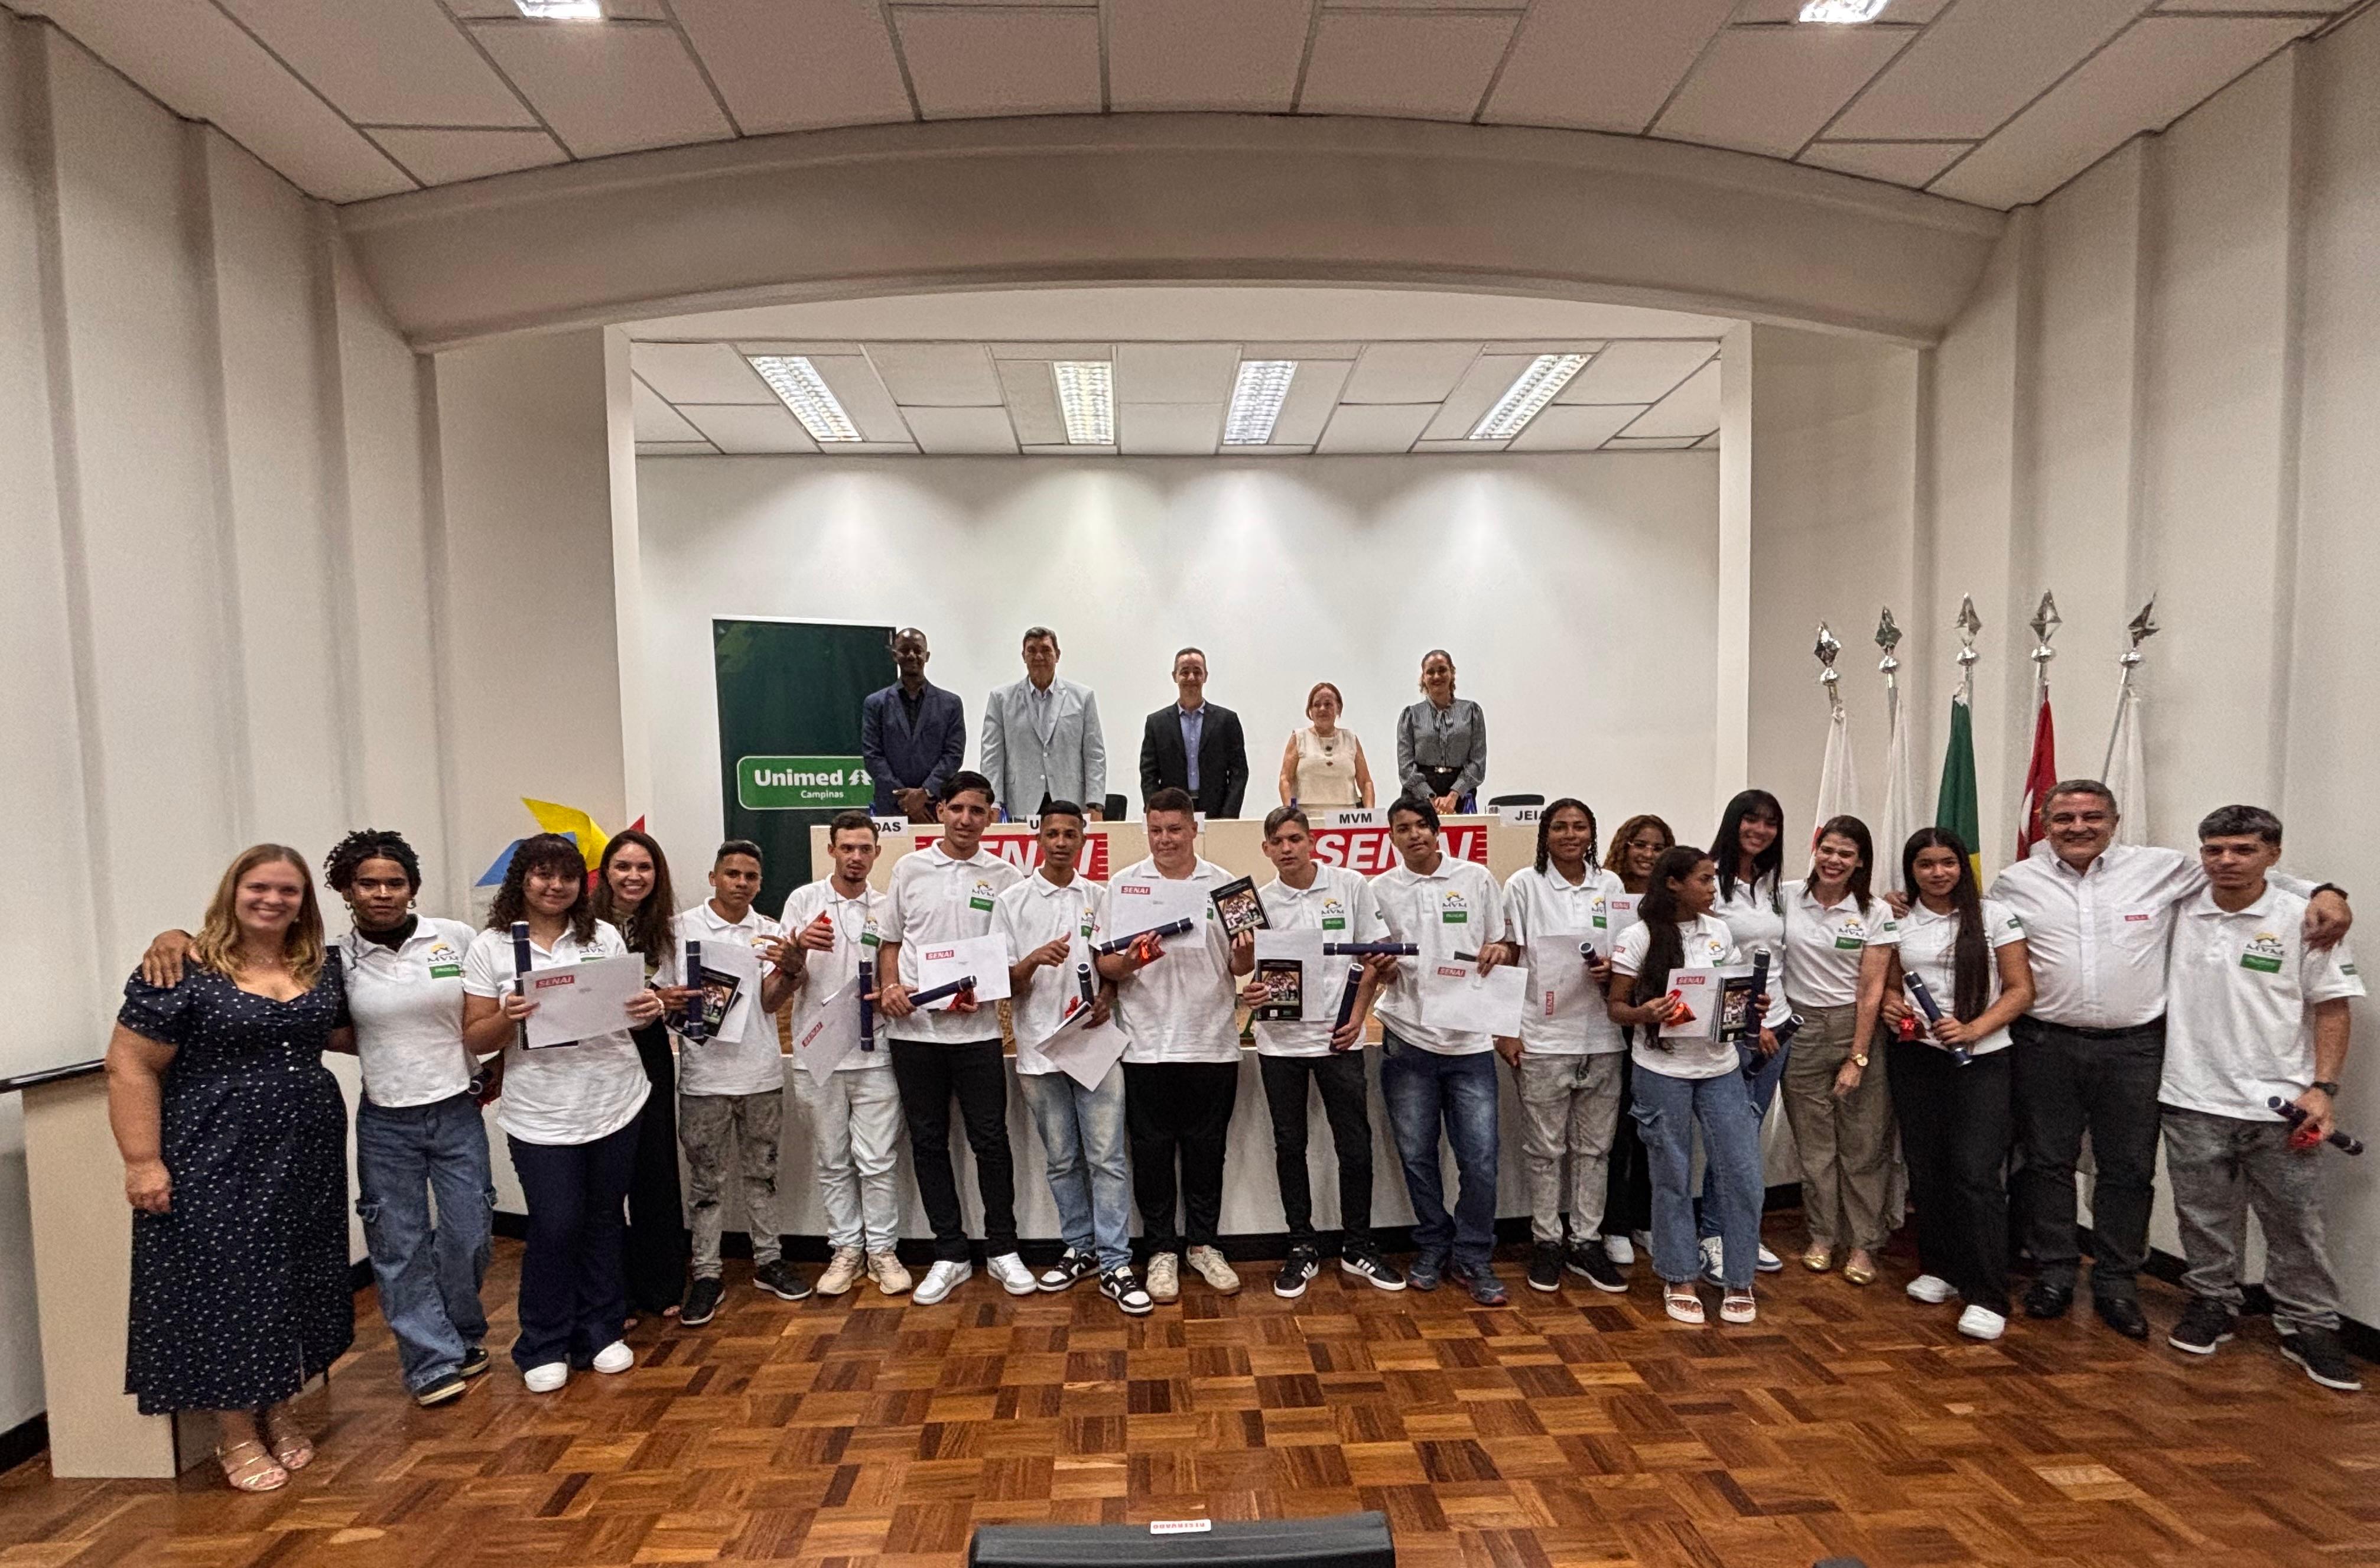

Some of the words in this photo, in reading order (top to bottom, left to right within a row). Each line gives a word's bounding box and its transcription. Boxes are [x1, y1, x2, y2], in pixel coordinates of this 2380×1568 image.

[755, 769, 843, 786] Unimed
[801, 789, 844, 800] Campinas
[1339, 813, 1372, 824] MVM
[1515, 810, 1541, 821] JEI
[1123, 886, 1150, 894] SENAI
[928, 951, 952, 959] SENAI
[1438, 967, 1464, 976] SENAI
[538, 977, 572, 988] SENAI
[1677, 977, 1703, 985] SENAI
